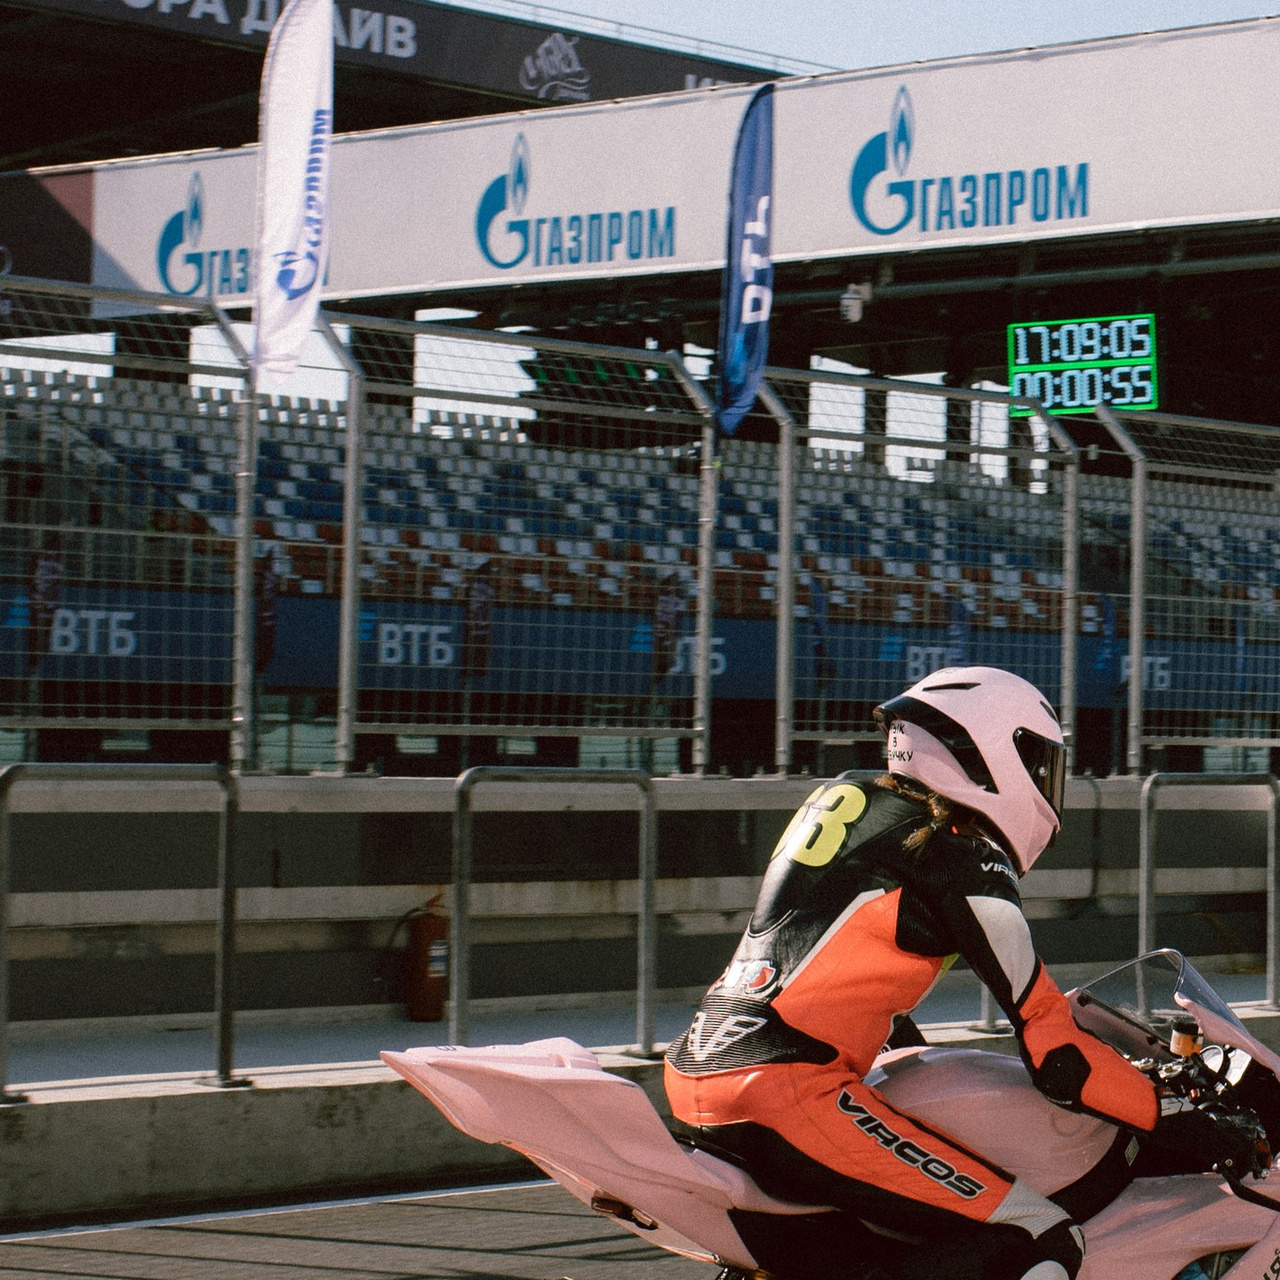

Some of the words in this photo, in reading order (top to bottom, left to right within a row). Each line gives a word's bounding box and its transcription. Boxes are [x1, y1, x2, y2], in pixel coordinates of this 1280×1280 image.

[920, 162, 1089, 232] ГАЗПРОМ
[532, 206, 676, 267] ГАЗПРОМ
[1014, 318, 1152, 365] 17:09:05
[1013, 365, 1153, 410] 00:00:55
[51, 608, 137, 656] ВТБ
[377, 622, 455, 666] ВТБ
[980, 862, 1019, 884] VIRC
[836, 1086, 988, 1200] VIRCOS
